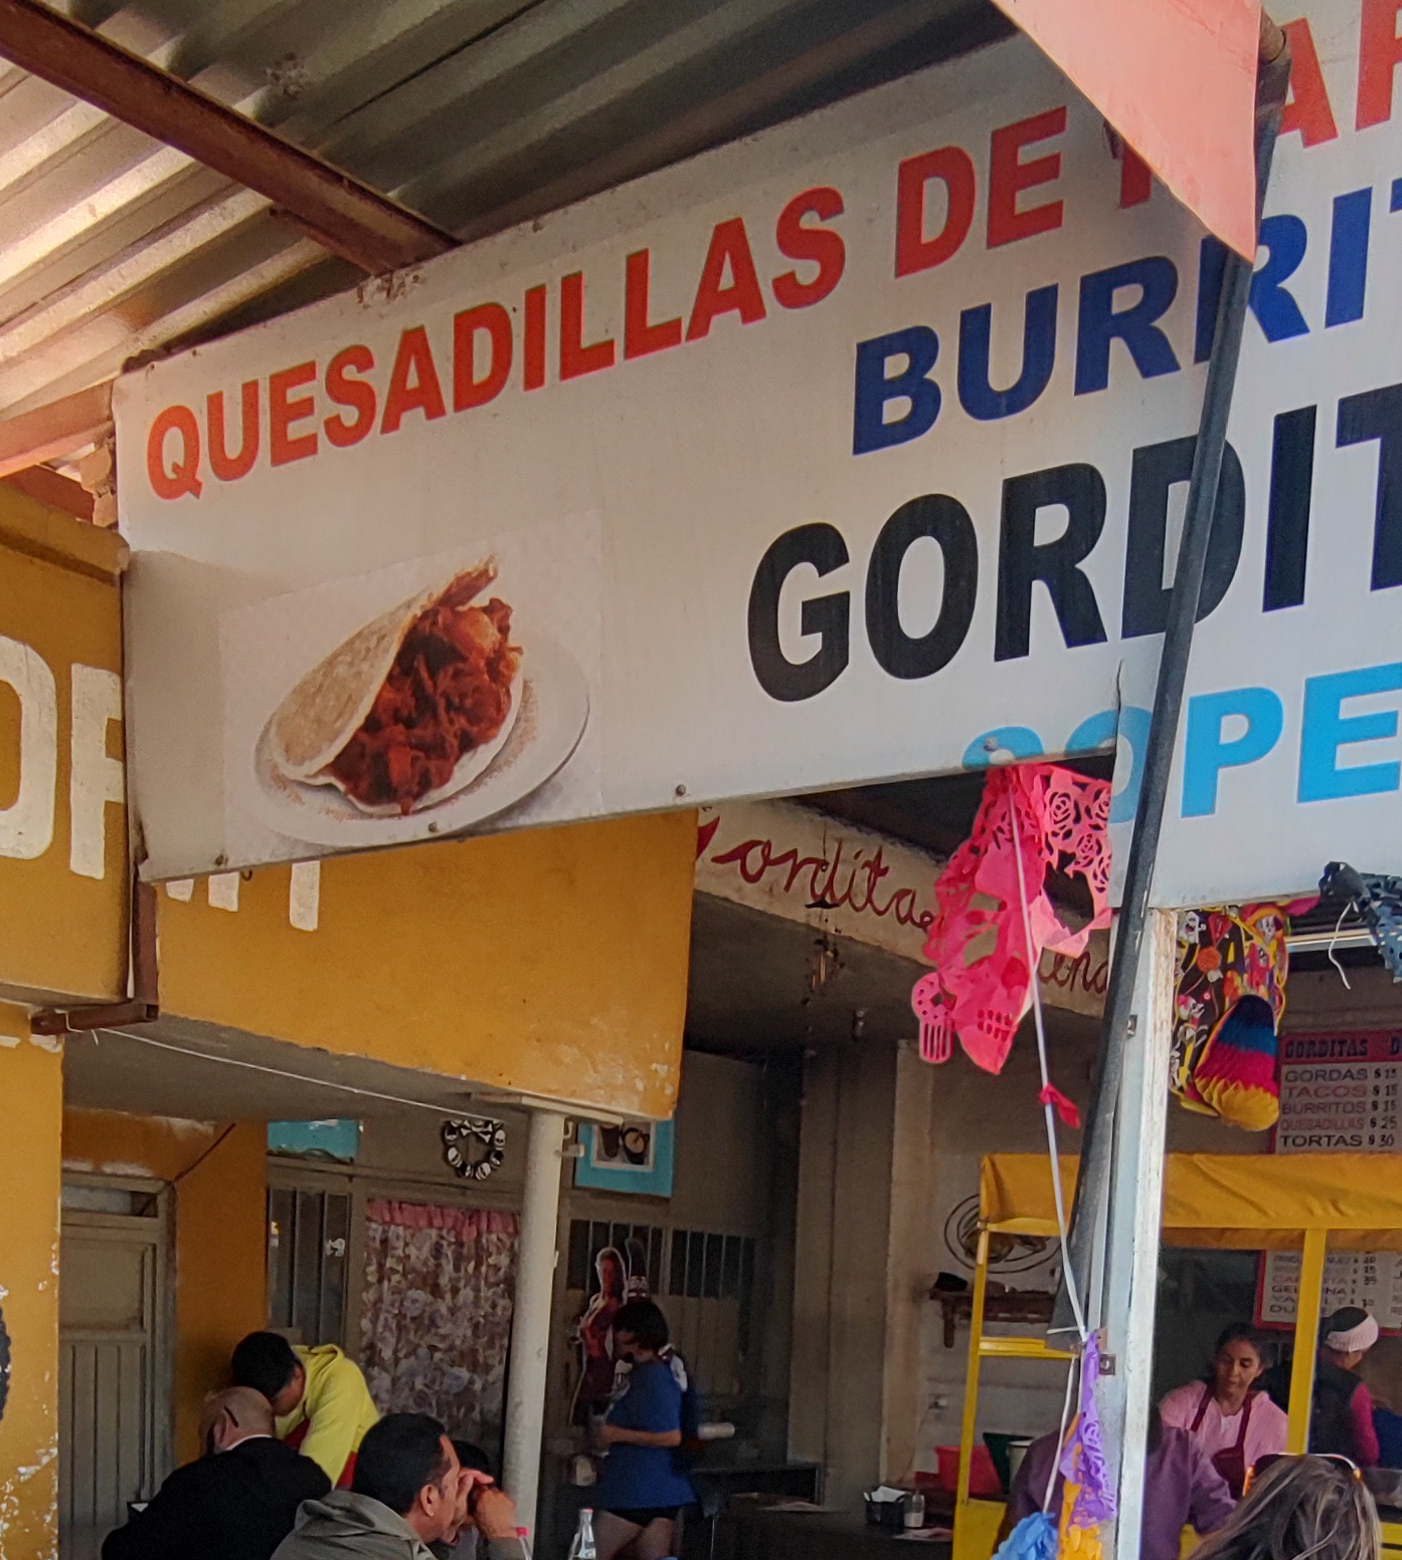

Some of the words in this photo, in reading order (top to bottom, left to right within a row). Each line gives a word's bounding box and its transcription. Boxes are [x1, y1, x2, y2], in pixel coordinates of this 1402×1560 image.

[146, 186, 845, 501] QUESADILLAS
[894, 106, 1068, 279] DE
[1284, 1068, 1368, 1083] GORDAS
[1286, 1084, 1368, 1098] TACOS
[1281, 1101, 1367, 1115] BURRITOS
[1280, 1134, 1363, 1148] TORTAS
